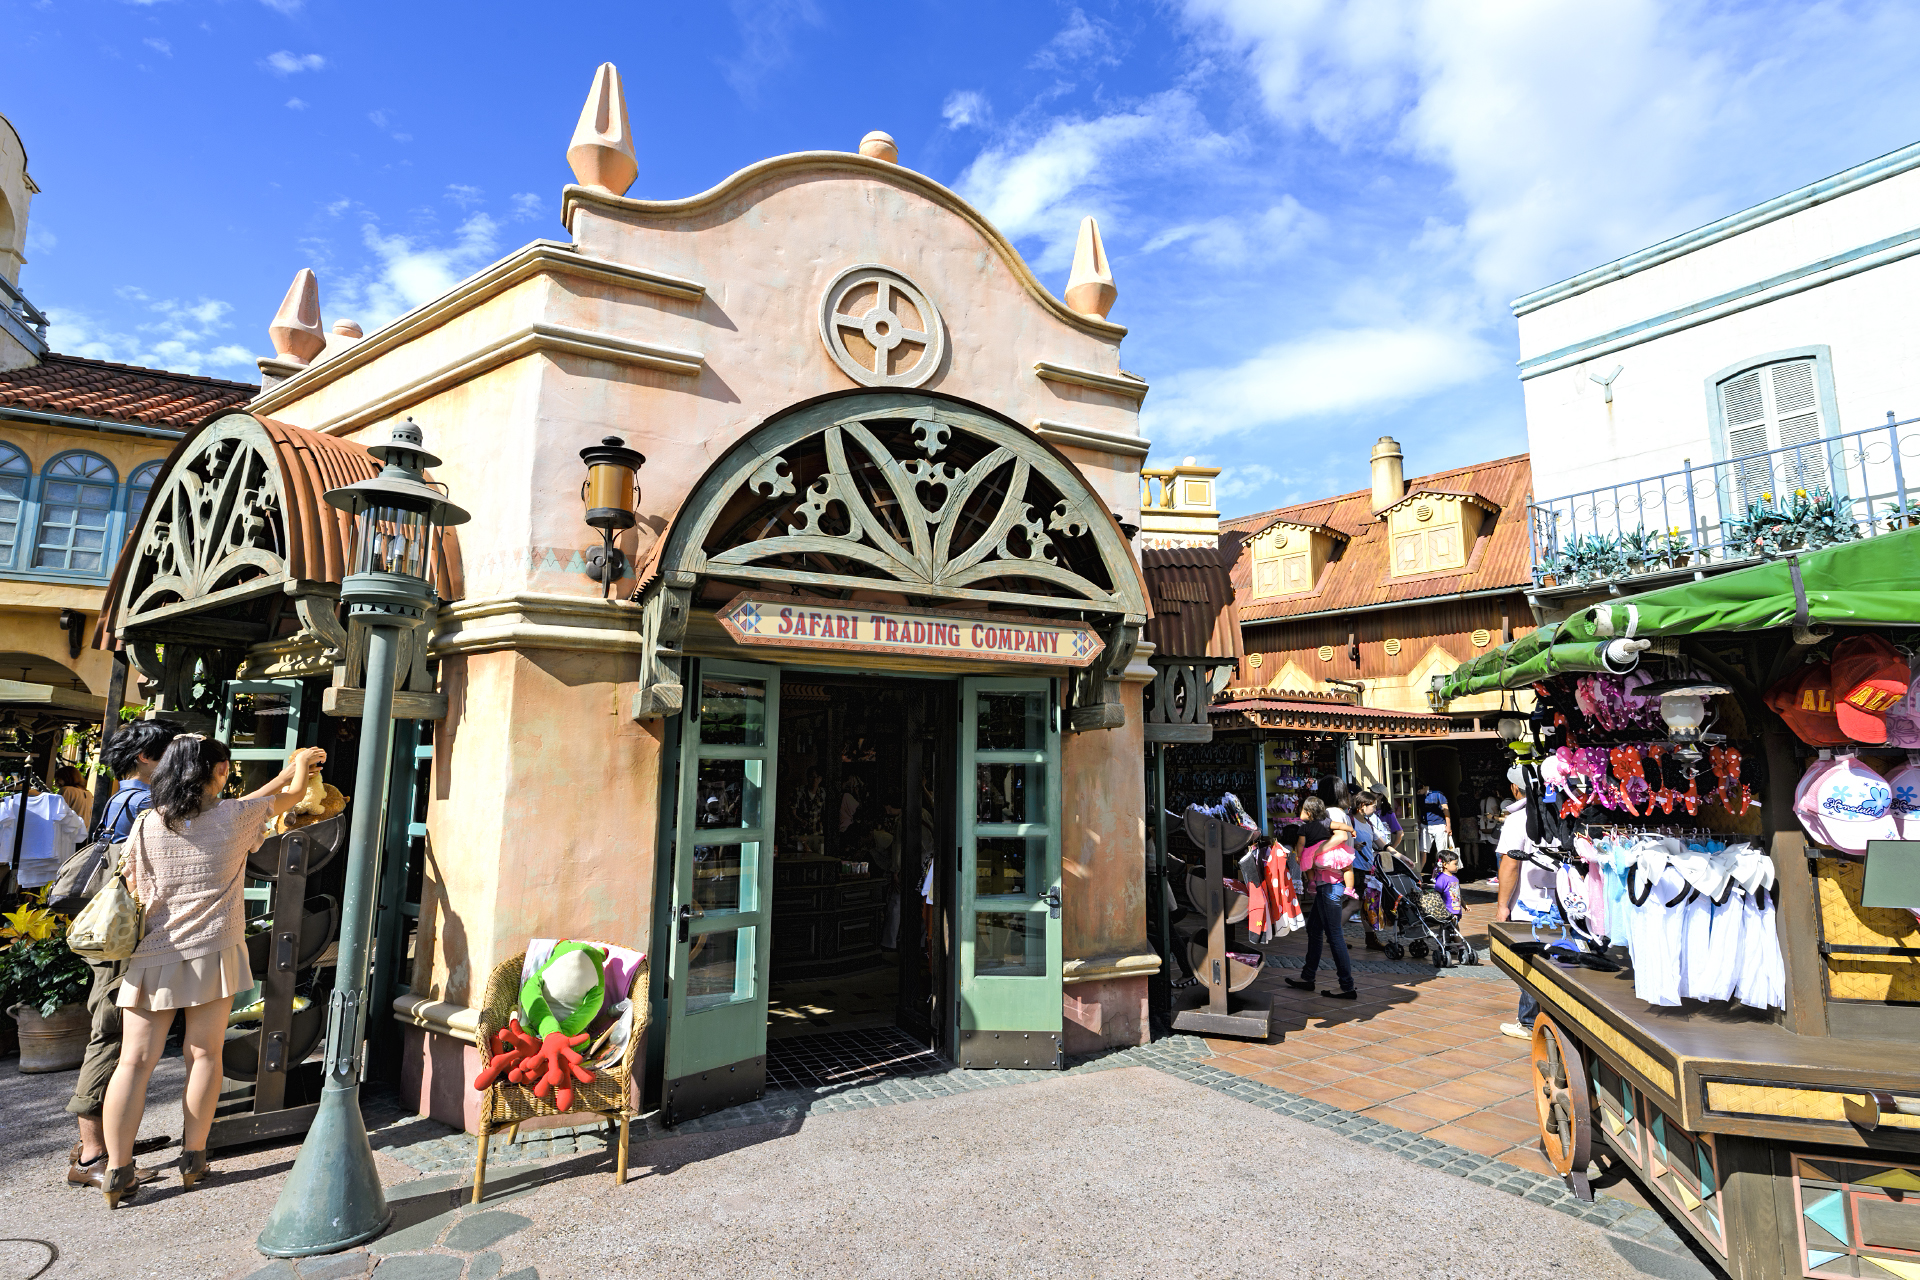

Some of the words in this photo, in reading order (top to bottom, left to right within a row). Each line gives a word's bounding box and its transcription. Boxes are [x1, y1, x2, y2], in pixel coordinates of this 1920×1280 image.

[778, 607, 859, 639] SAFARI
[870, 615, 961, 647] TRADING
[971, 623, 1060, 653] COMPANY
[1801, 689, 1836, 713] AL
[1823, 797, 1879, 817] Honolulu
